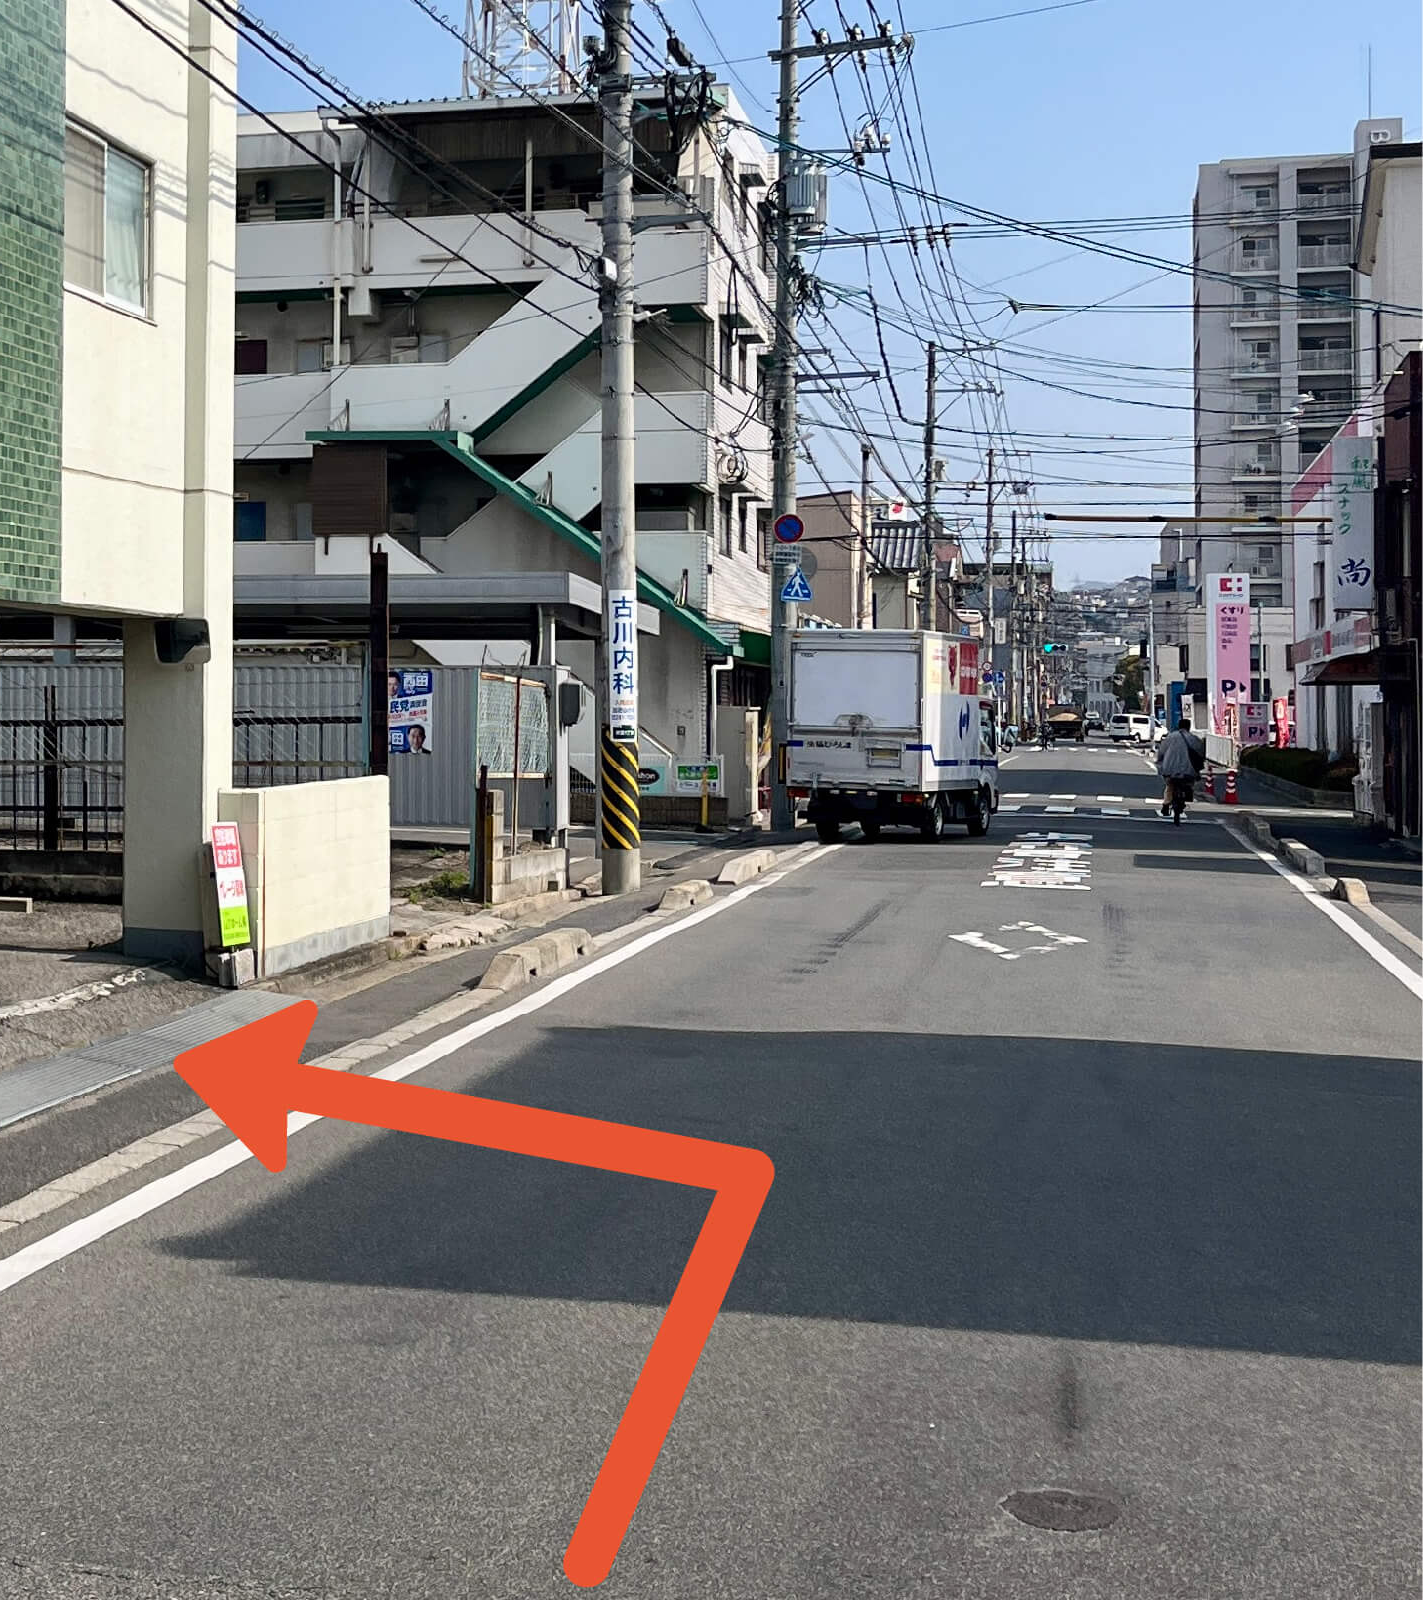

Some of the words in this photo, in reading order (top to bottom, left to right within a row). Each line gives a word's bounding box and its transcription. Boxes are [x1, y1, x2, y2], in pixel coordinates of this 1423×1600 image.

[1338, 483, 1352, 536] スナック
[1338, 558, 1371, 587] 尚
[1220, 606, 1244, 615] くすり
[612, 596, 634, 695] 古川内科
[1221, 680, 1236, 697] P
